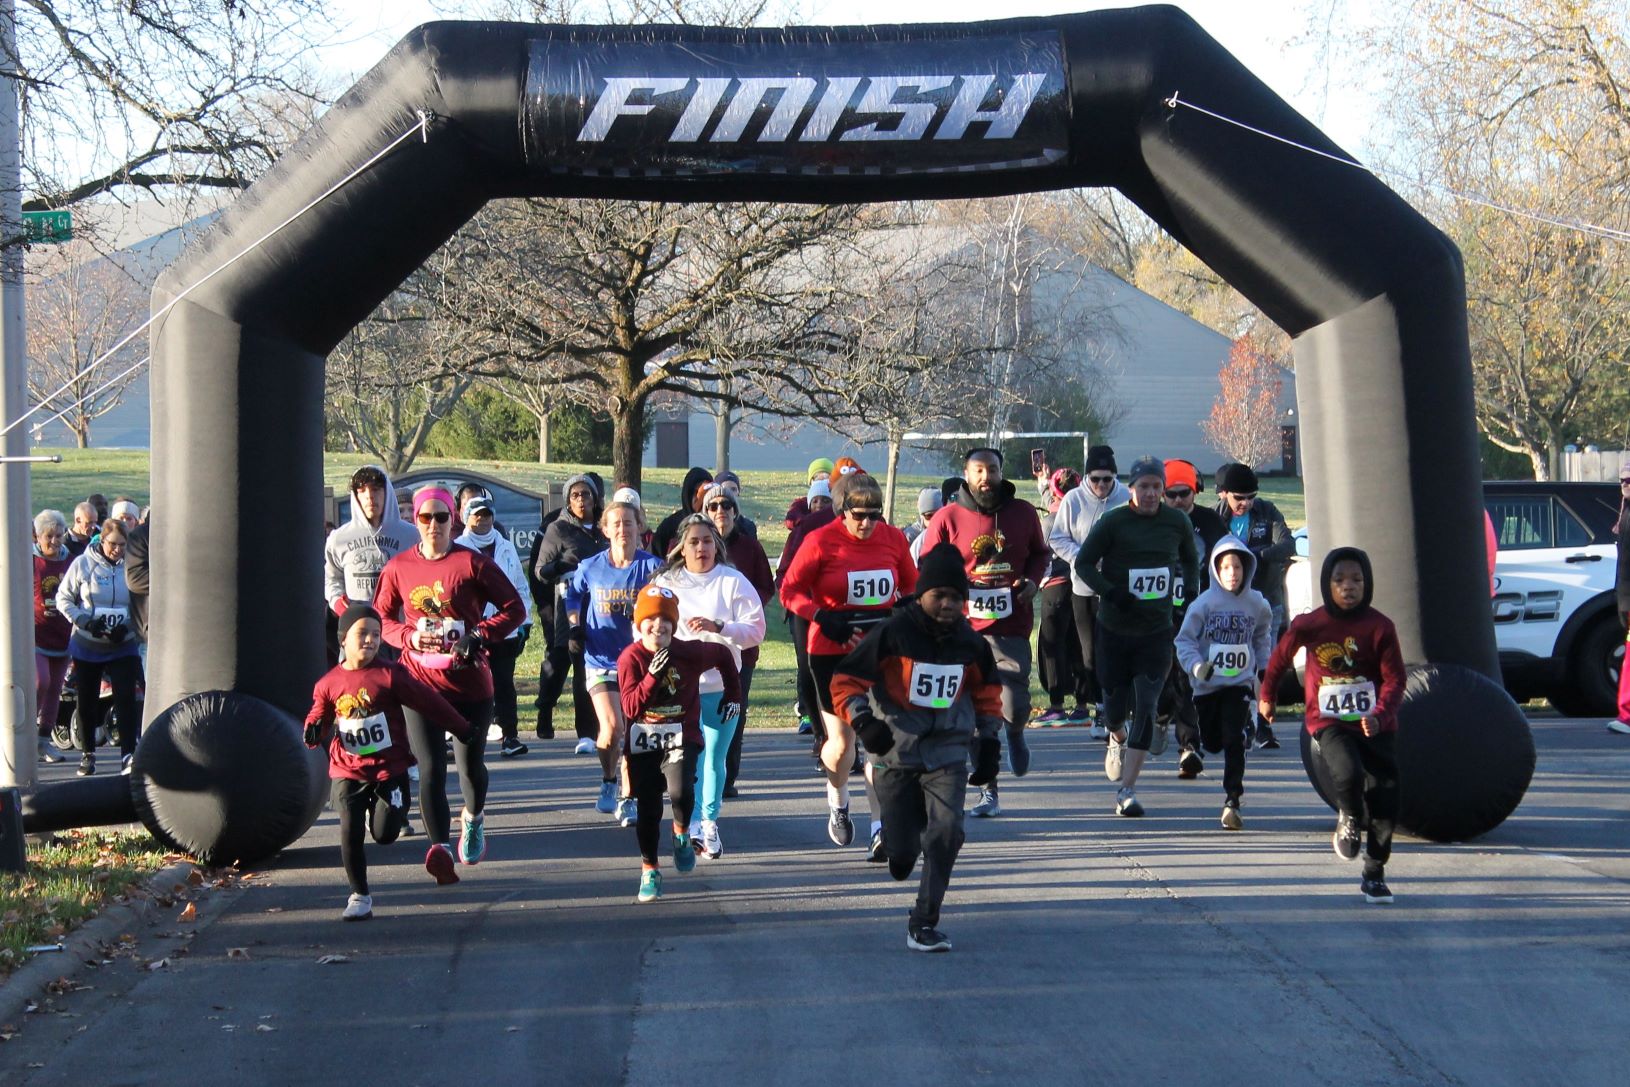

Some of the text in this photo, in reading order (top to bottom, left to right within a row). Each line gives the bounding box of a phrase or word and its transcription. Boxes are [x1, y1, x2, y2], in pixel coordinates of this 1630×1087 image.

[576, 73, 1047, 142] FINISH
[347, 535, 400, 552] CALIFORNIA
[853, 577, 890, 598] 510
[1133, 575, 1166, 592] 476
[973, 595, 1007, 612] 445
[100, 614, 124, 628] 402
[1208, 616, 1245, 629] CROSS
[1213, 652, 1247, 669] 490
[916, 673, 958, 698] 515
[1325, 691, 1370, 713] 446
[345, 723, 385, 747] 406
[635, 732, 676, 751] 438
